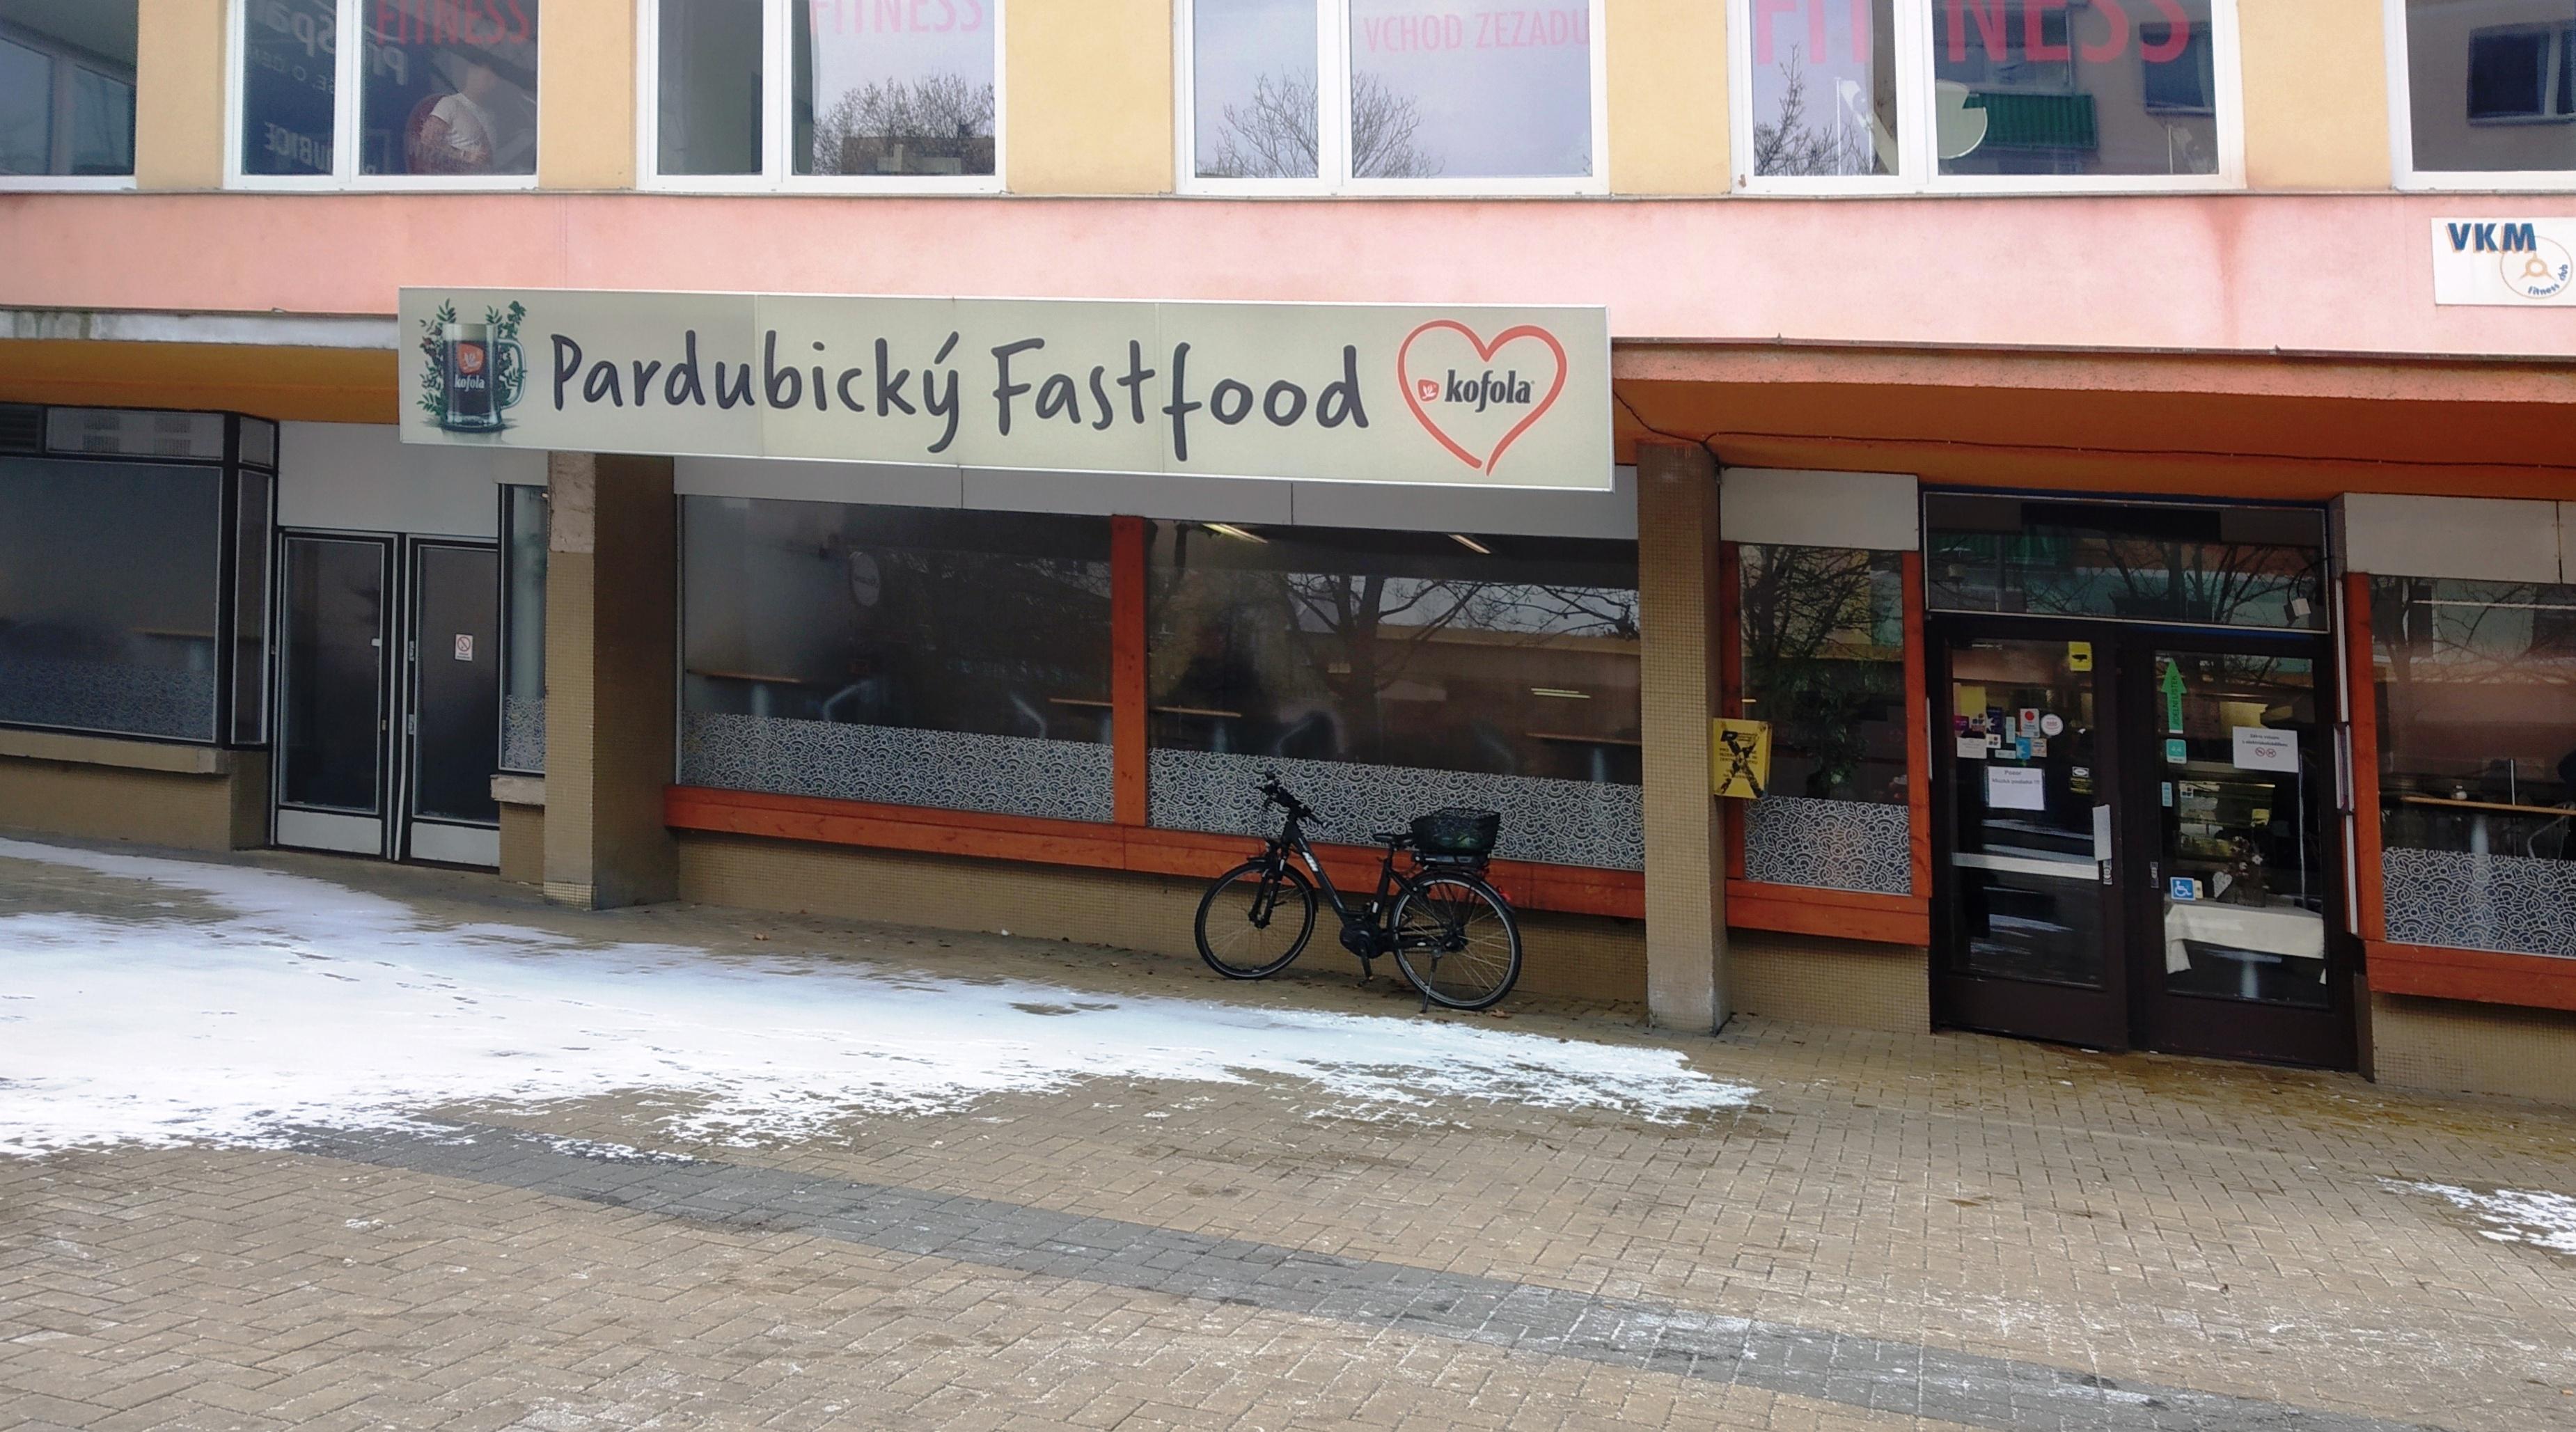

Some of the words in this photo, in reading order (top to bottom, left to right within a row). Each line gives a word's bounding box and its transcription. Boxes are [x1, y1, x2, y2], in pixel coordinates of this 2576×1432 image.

[1363, 14, 1463, 53] VCHOD
[1475, 9, 1589, 49] ZEZADU
[2445, 222, 2537, 253] VKM
[455, 374, 485, 392] kofola
[550, 329, 959, 453] Pardubický
[991, 338, 1369, 462] Fastfood
[1445, 369, 1532, 413] kofola
